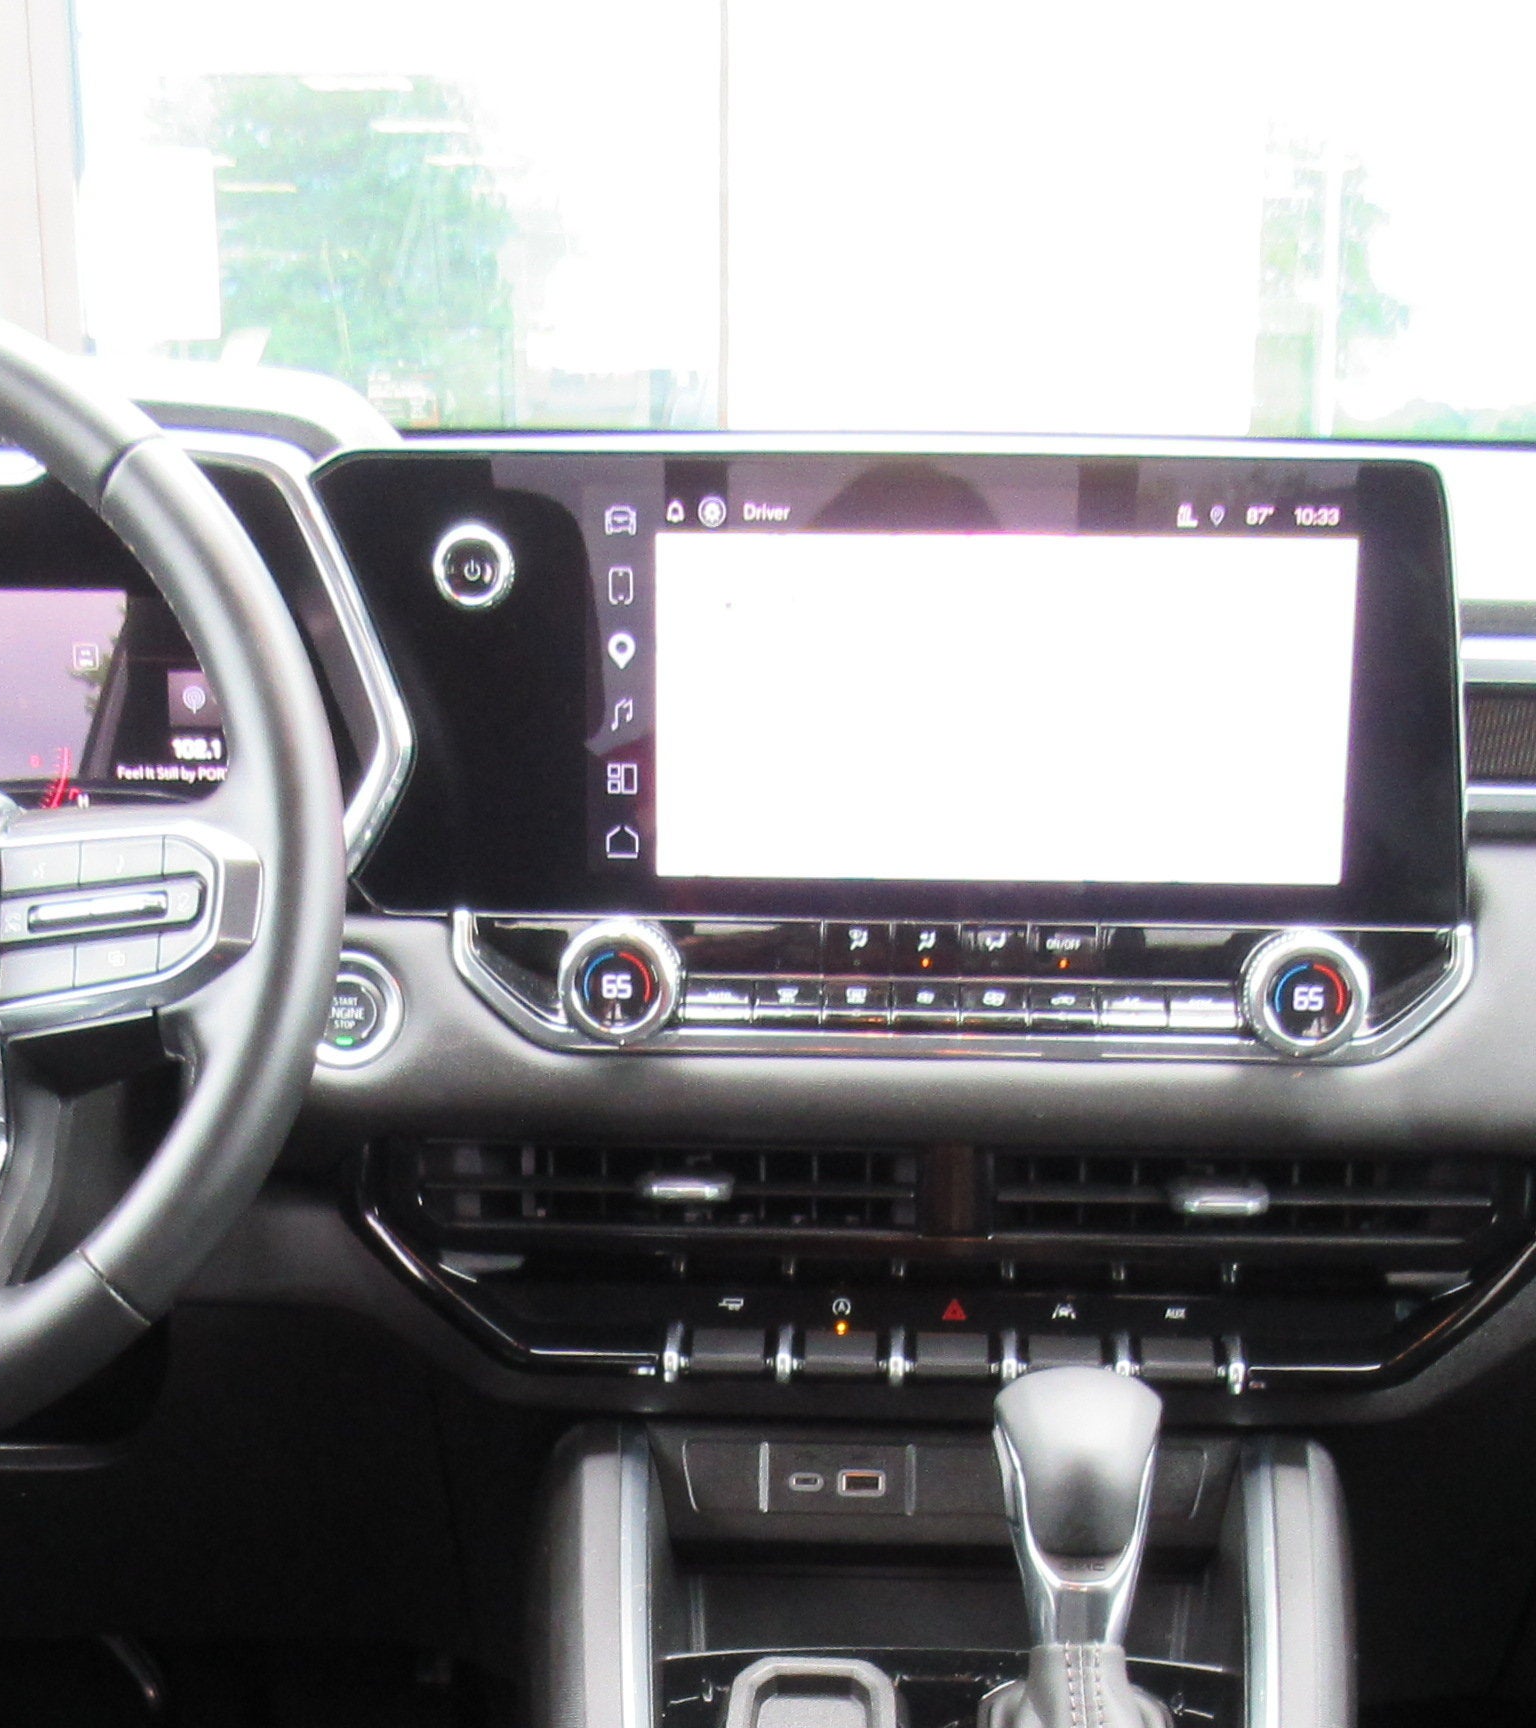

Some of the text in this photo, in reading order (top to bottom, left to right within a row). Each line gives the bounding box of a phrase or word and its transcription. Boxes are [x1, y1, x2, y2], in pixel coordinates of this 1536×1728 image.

[743, 502, 790, 520] Driver
[1294, 507, 1340, 526] 10:33
[172, 738, 221, 759] 102.1
[117, 764, 144, 780] Feel
[156, 765, 179, 781] Still
[181, 765, 196, 784] by
[198, 766, 228, 782] POR
[602, 973, 632, 999] 65
[333, 996, 357, 1006] START
[1293, 985, 1324, 1011] 65
[329, 1007, 364, 1020] NGINE
[334, 1020, 355, 1029] STOP
[1165, 1307, 1186, 1319] AUX
